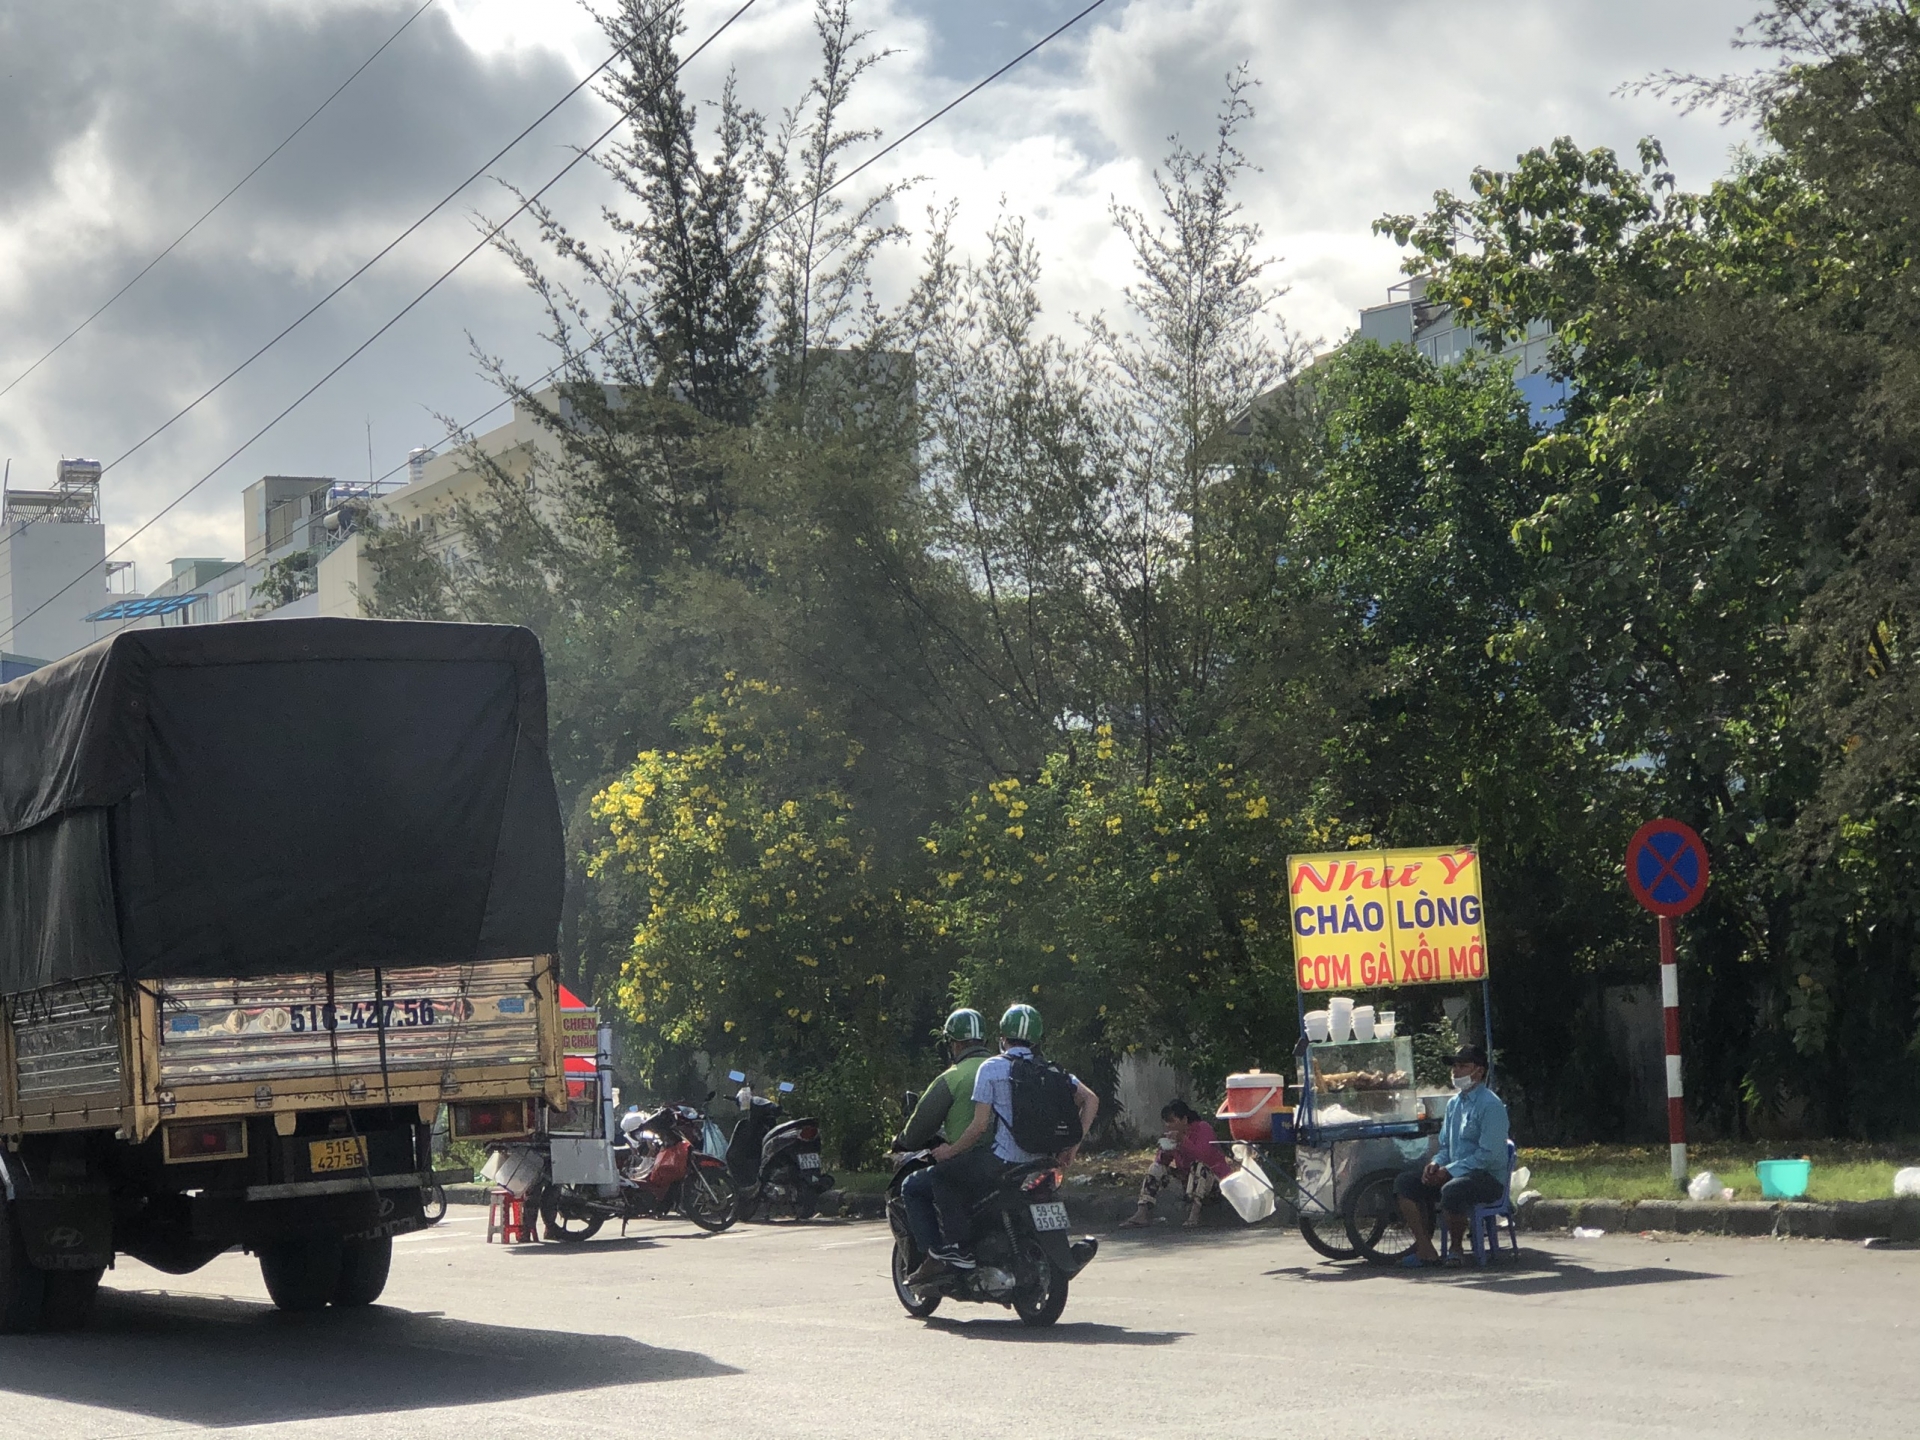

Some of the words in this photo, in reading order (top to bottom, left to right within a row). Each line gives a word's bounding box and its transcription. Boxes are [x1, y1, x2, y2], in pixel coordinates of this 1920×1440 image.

[1291, 860, 1423, 894] Như
[1294, 894, 1384, 937] CHÁO
[1396, 889, 1481, 930] LÒNG
[1297, 953, 1352, 991] CƠM
[1360, 942, 1394, 987] GÀ
[1400, 932, 1441, 983] XỐI
[1449, 935, 1485, 979] MỠ
[326, 1140, 351, 1155] 51C
[318, 1153, 362, 1169] 427.56
[1036, 1205, 1062, 1216] 59-C2
